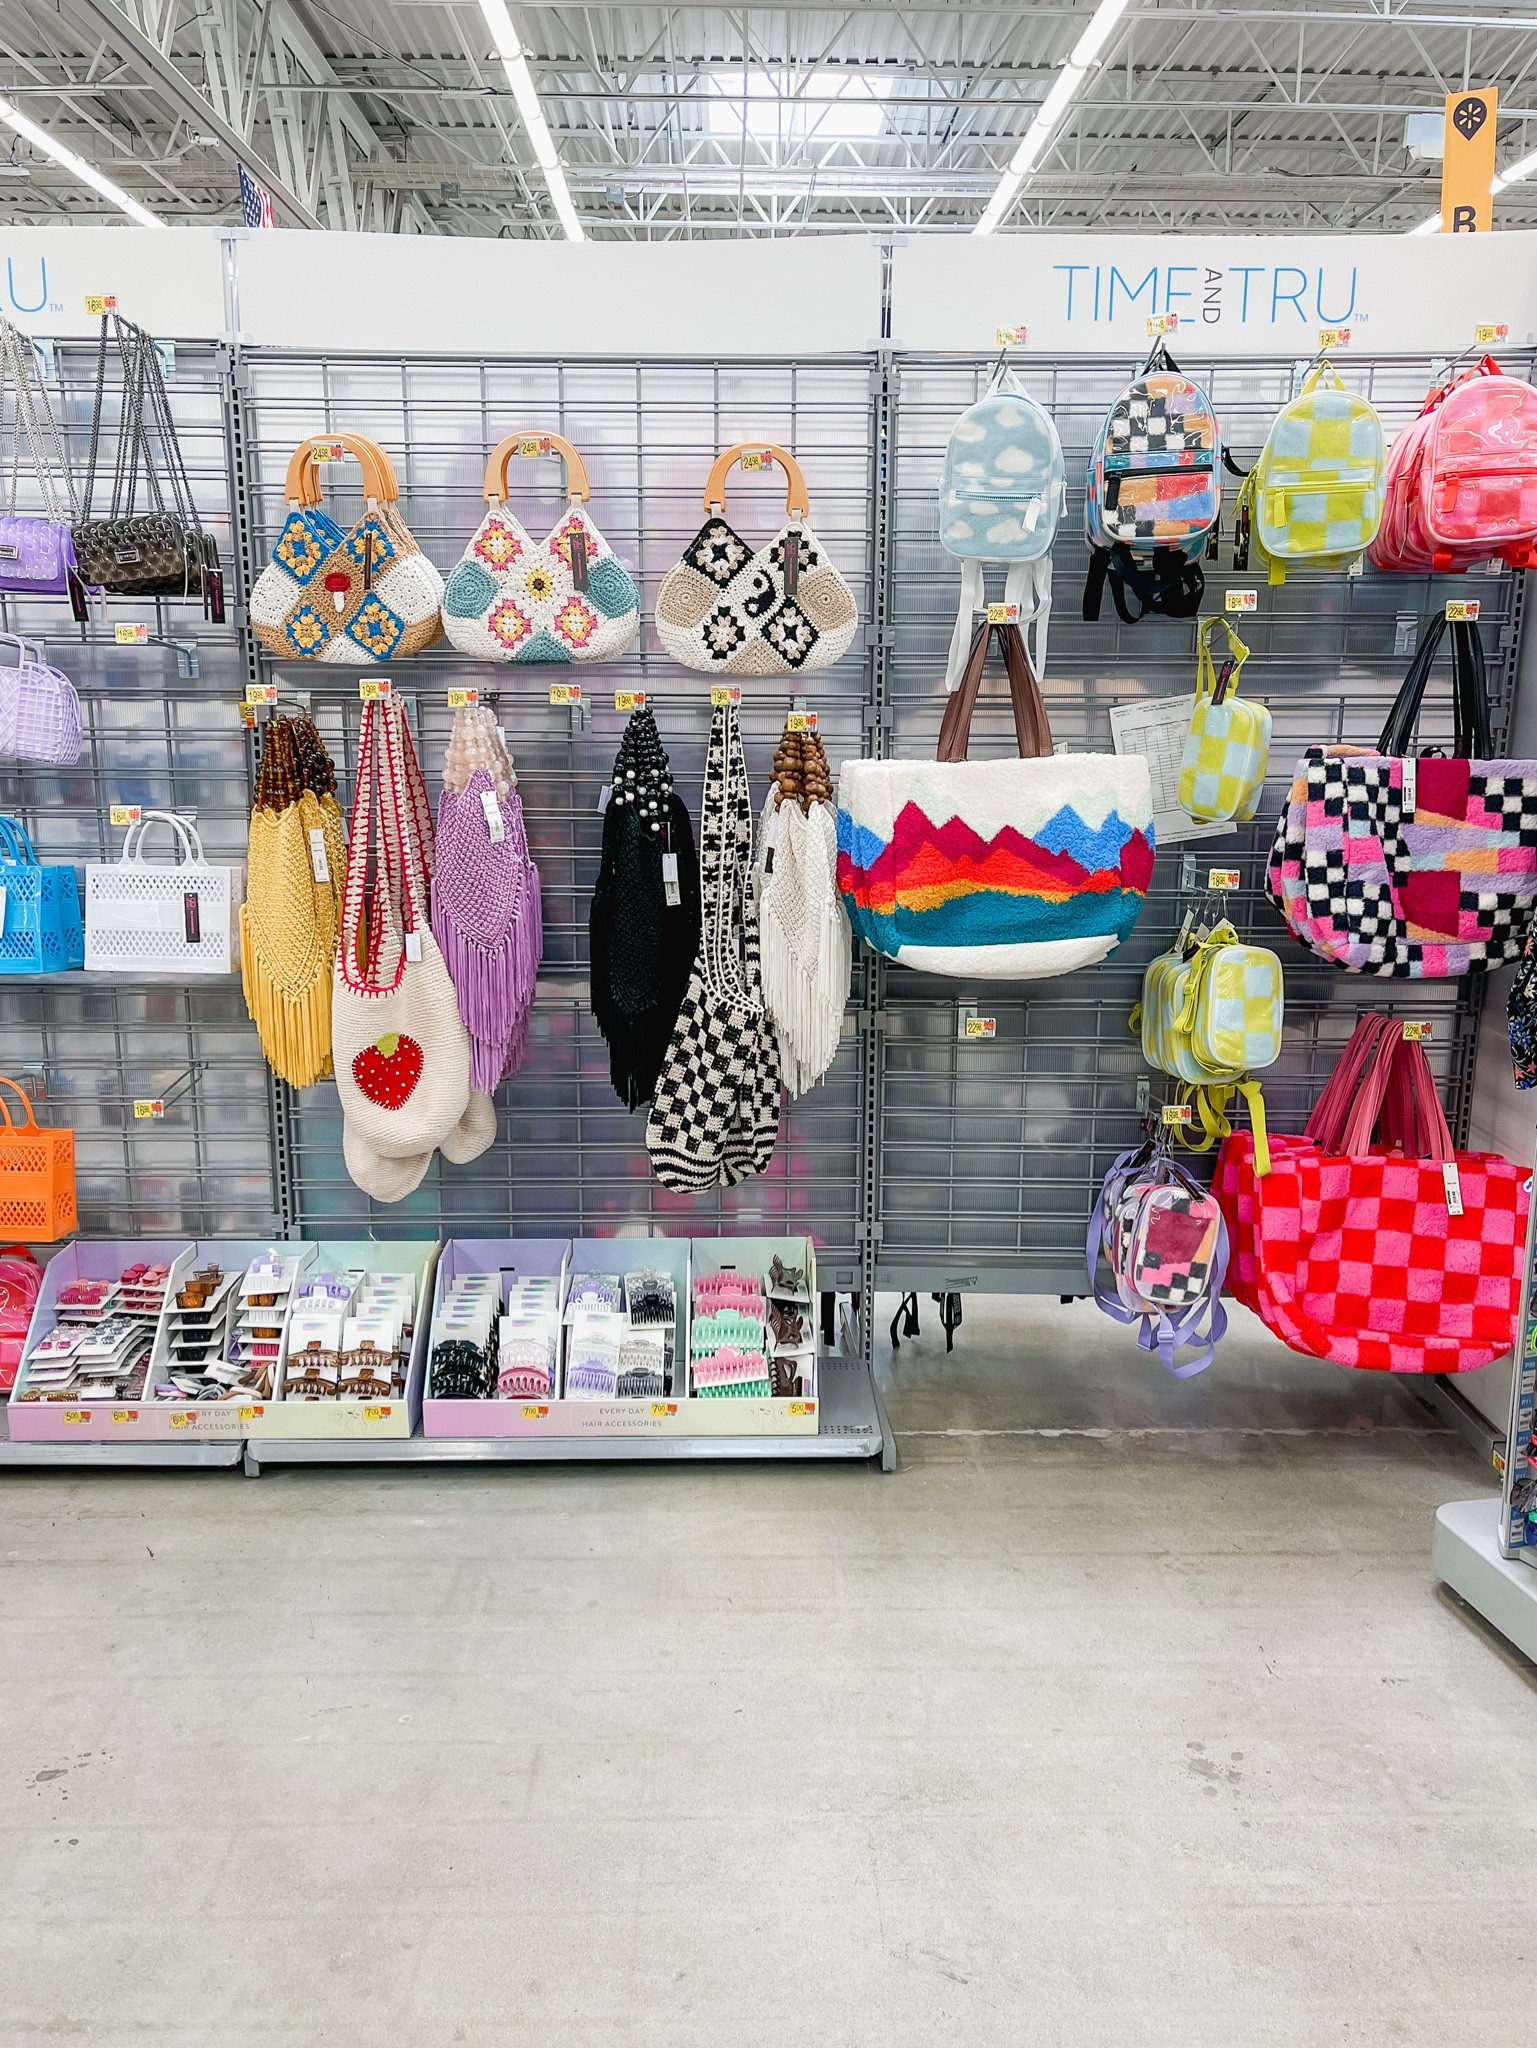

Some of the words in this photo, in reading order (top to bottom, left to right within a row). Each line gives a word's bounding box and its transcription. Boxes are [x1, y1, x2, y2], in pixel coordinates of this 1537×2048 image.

[1453, 206, 1476, 233] B
[0, 257, 47, 313] U
[1053, 266, 1198, 323] TIME
[1202, 268, 1223, 324] AND
[1228, 267, 1357, 323] TRU
